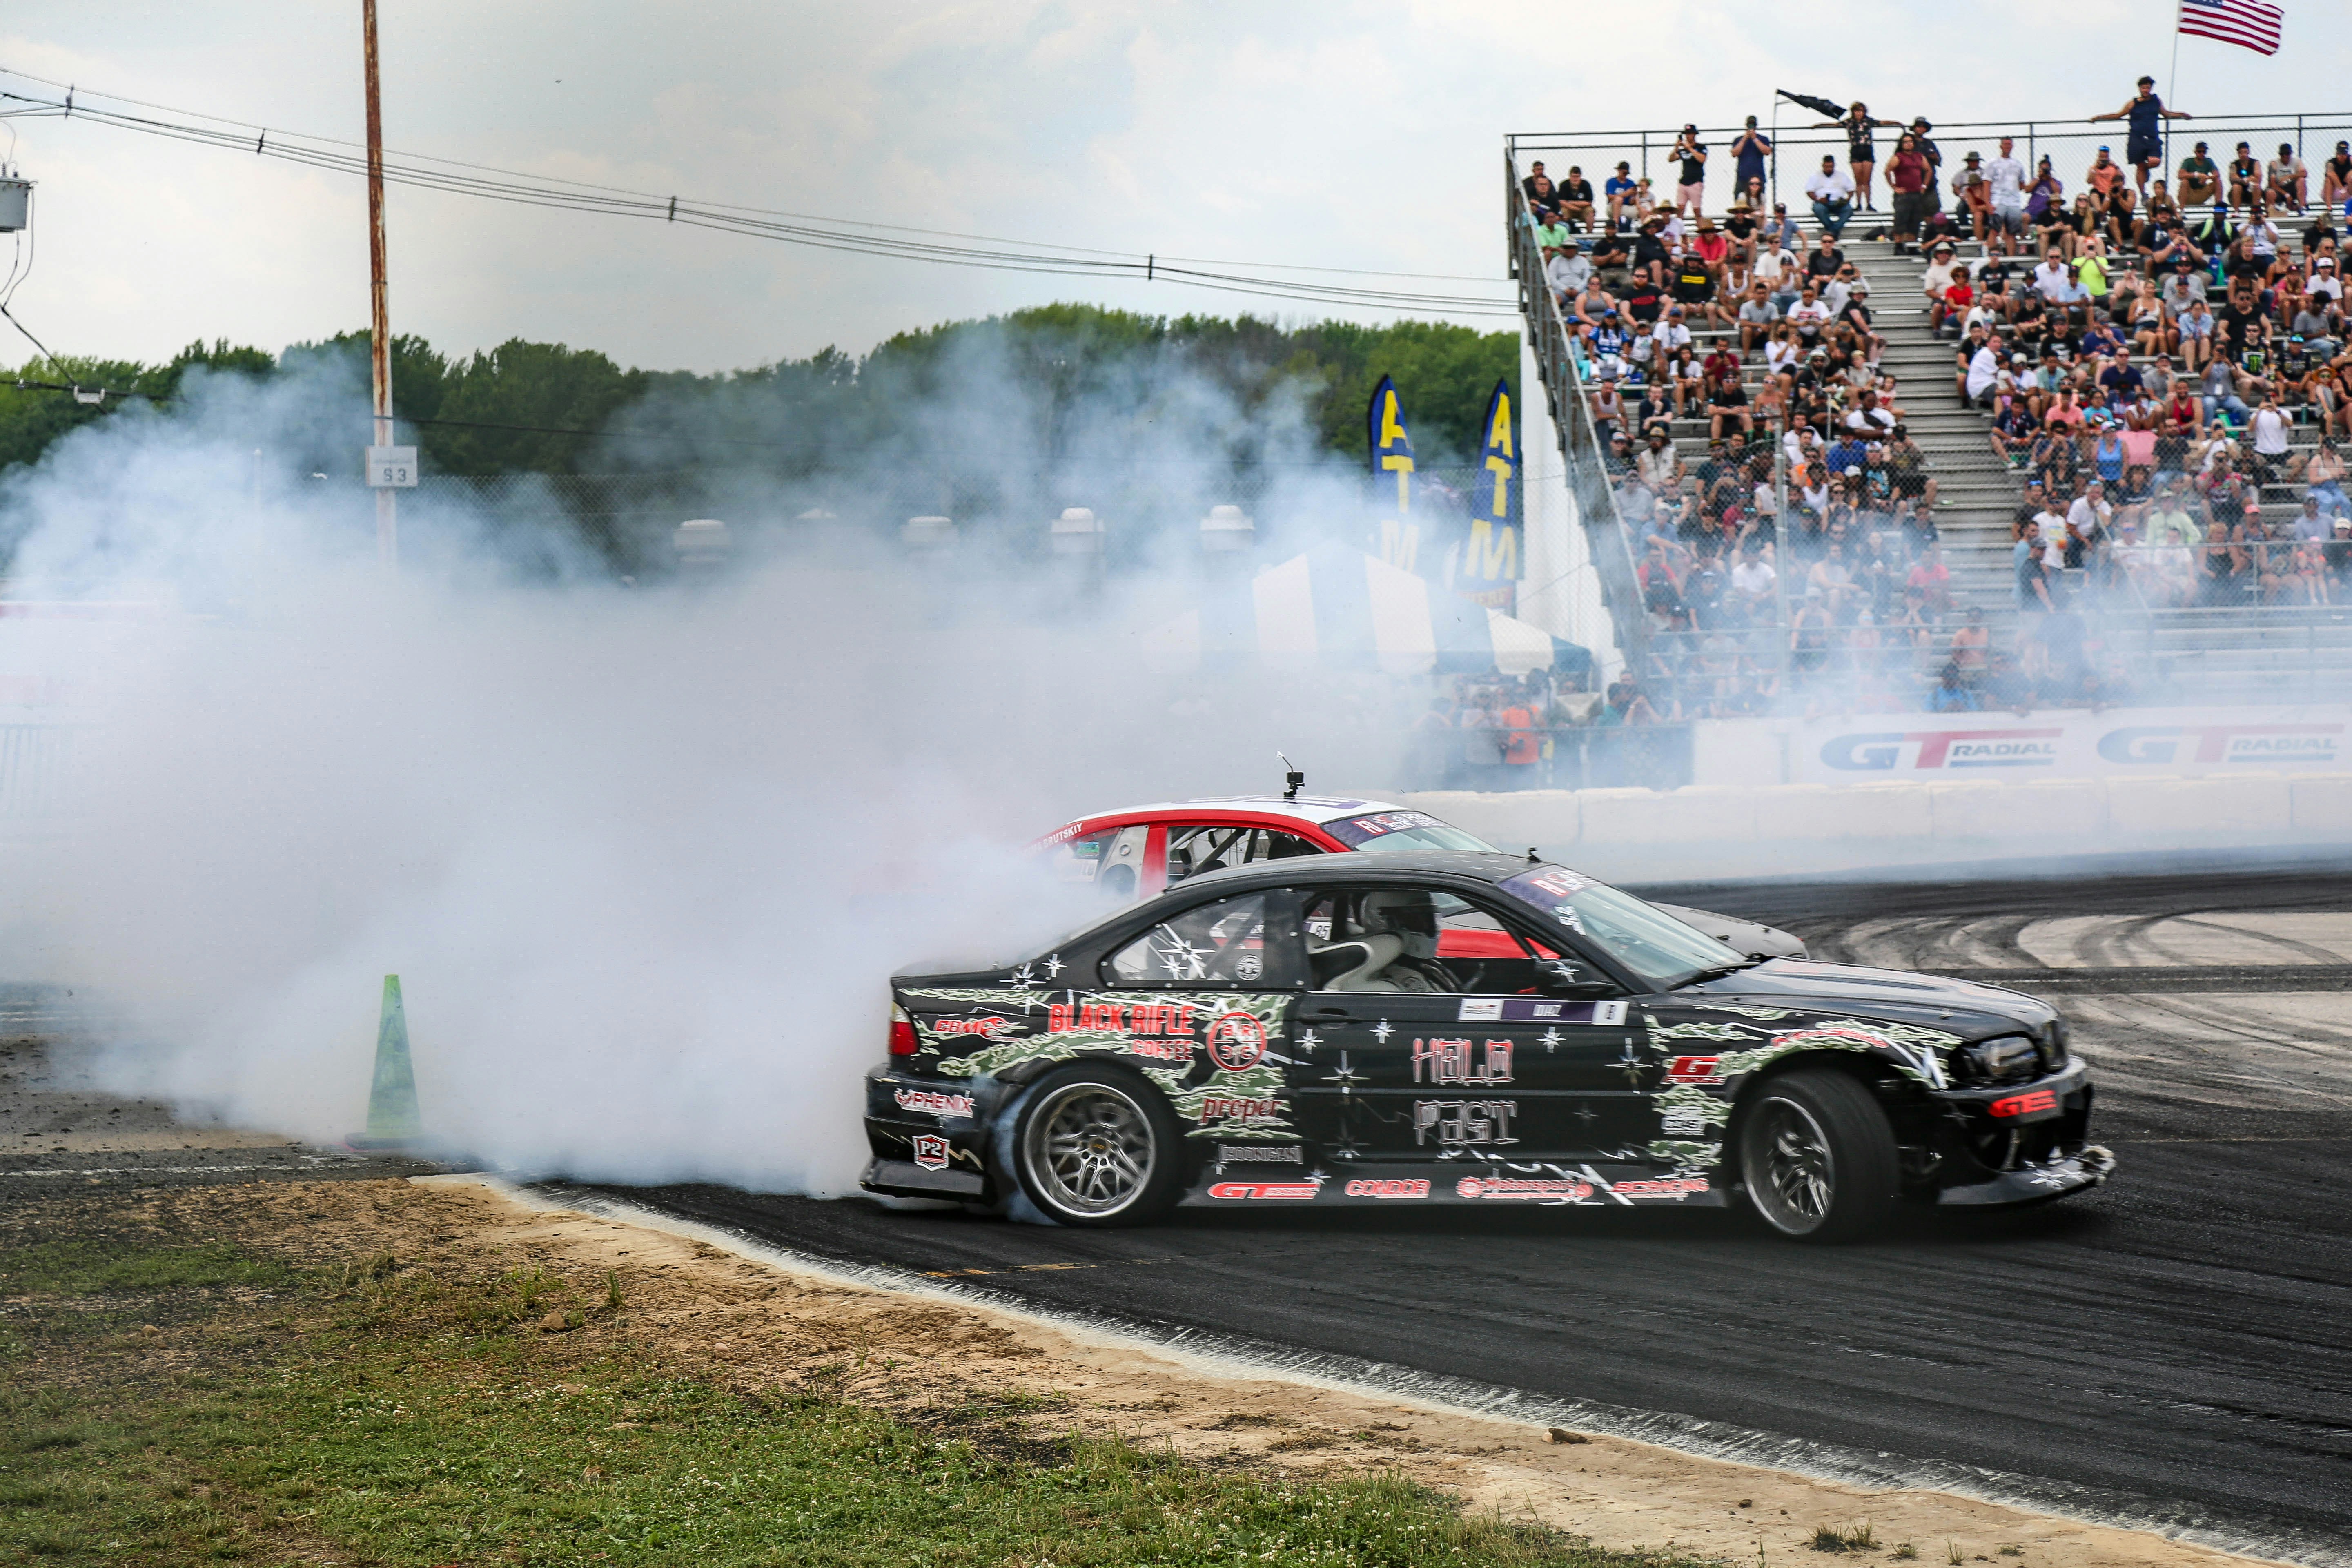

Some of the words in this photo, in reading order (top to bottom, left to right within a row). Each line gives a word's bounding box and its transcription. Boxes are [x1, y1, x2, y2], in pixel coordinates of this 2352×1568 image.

[1379, 390, 1419, 572] ATM
[1464, 392, 1517, 581] ATM
[1953, 743, 2057, 756] RADIAL
[2231, 738, 2339, 751] RADIAL
[1043, 822, 1083, 849] BRUTSKIY
[1316, 925, 1330, 938] 85
[1049, 1004, 1126, 1033] BLACK
[1131, 1004, 1196, 1035] RIFLE
[1532, 1004, 1563, 1017] DIAZ
[1132, 1039, 1194, 1061] COFFEE
[910, 1091, 975, 1114] PHENIX
[920, 1140, 942, 1156] P2
[1345, 1179, 1431, 1197] CONDOR
